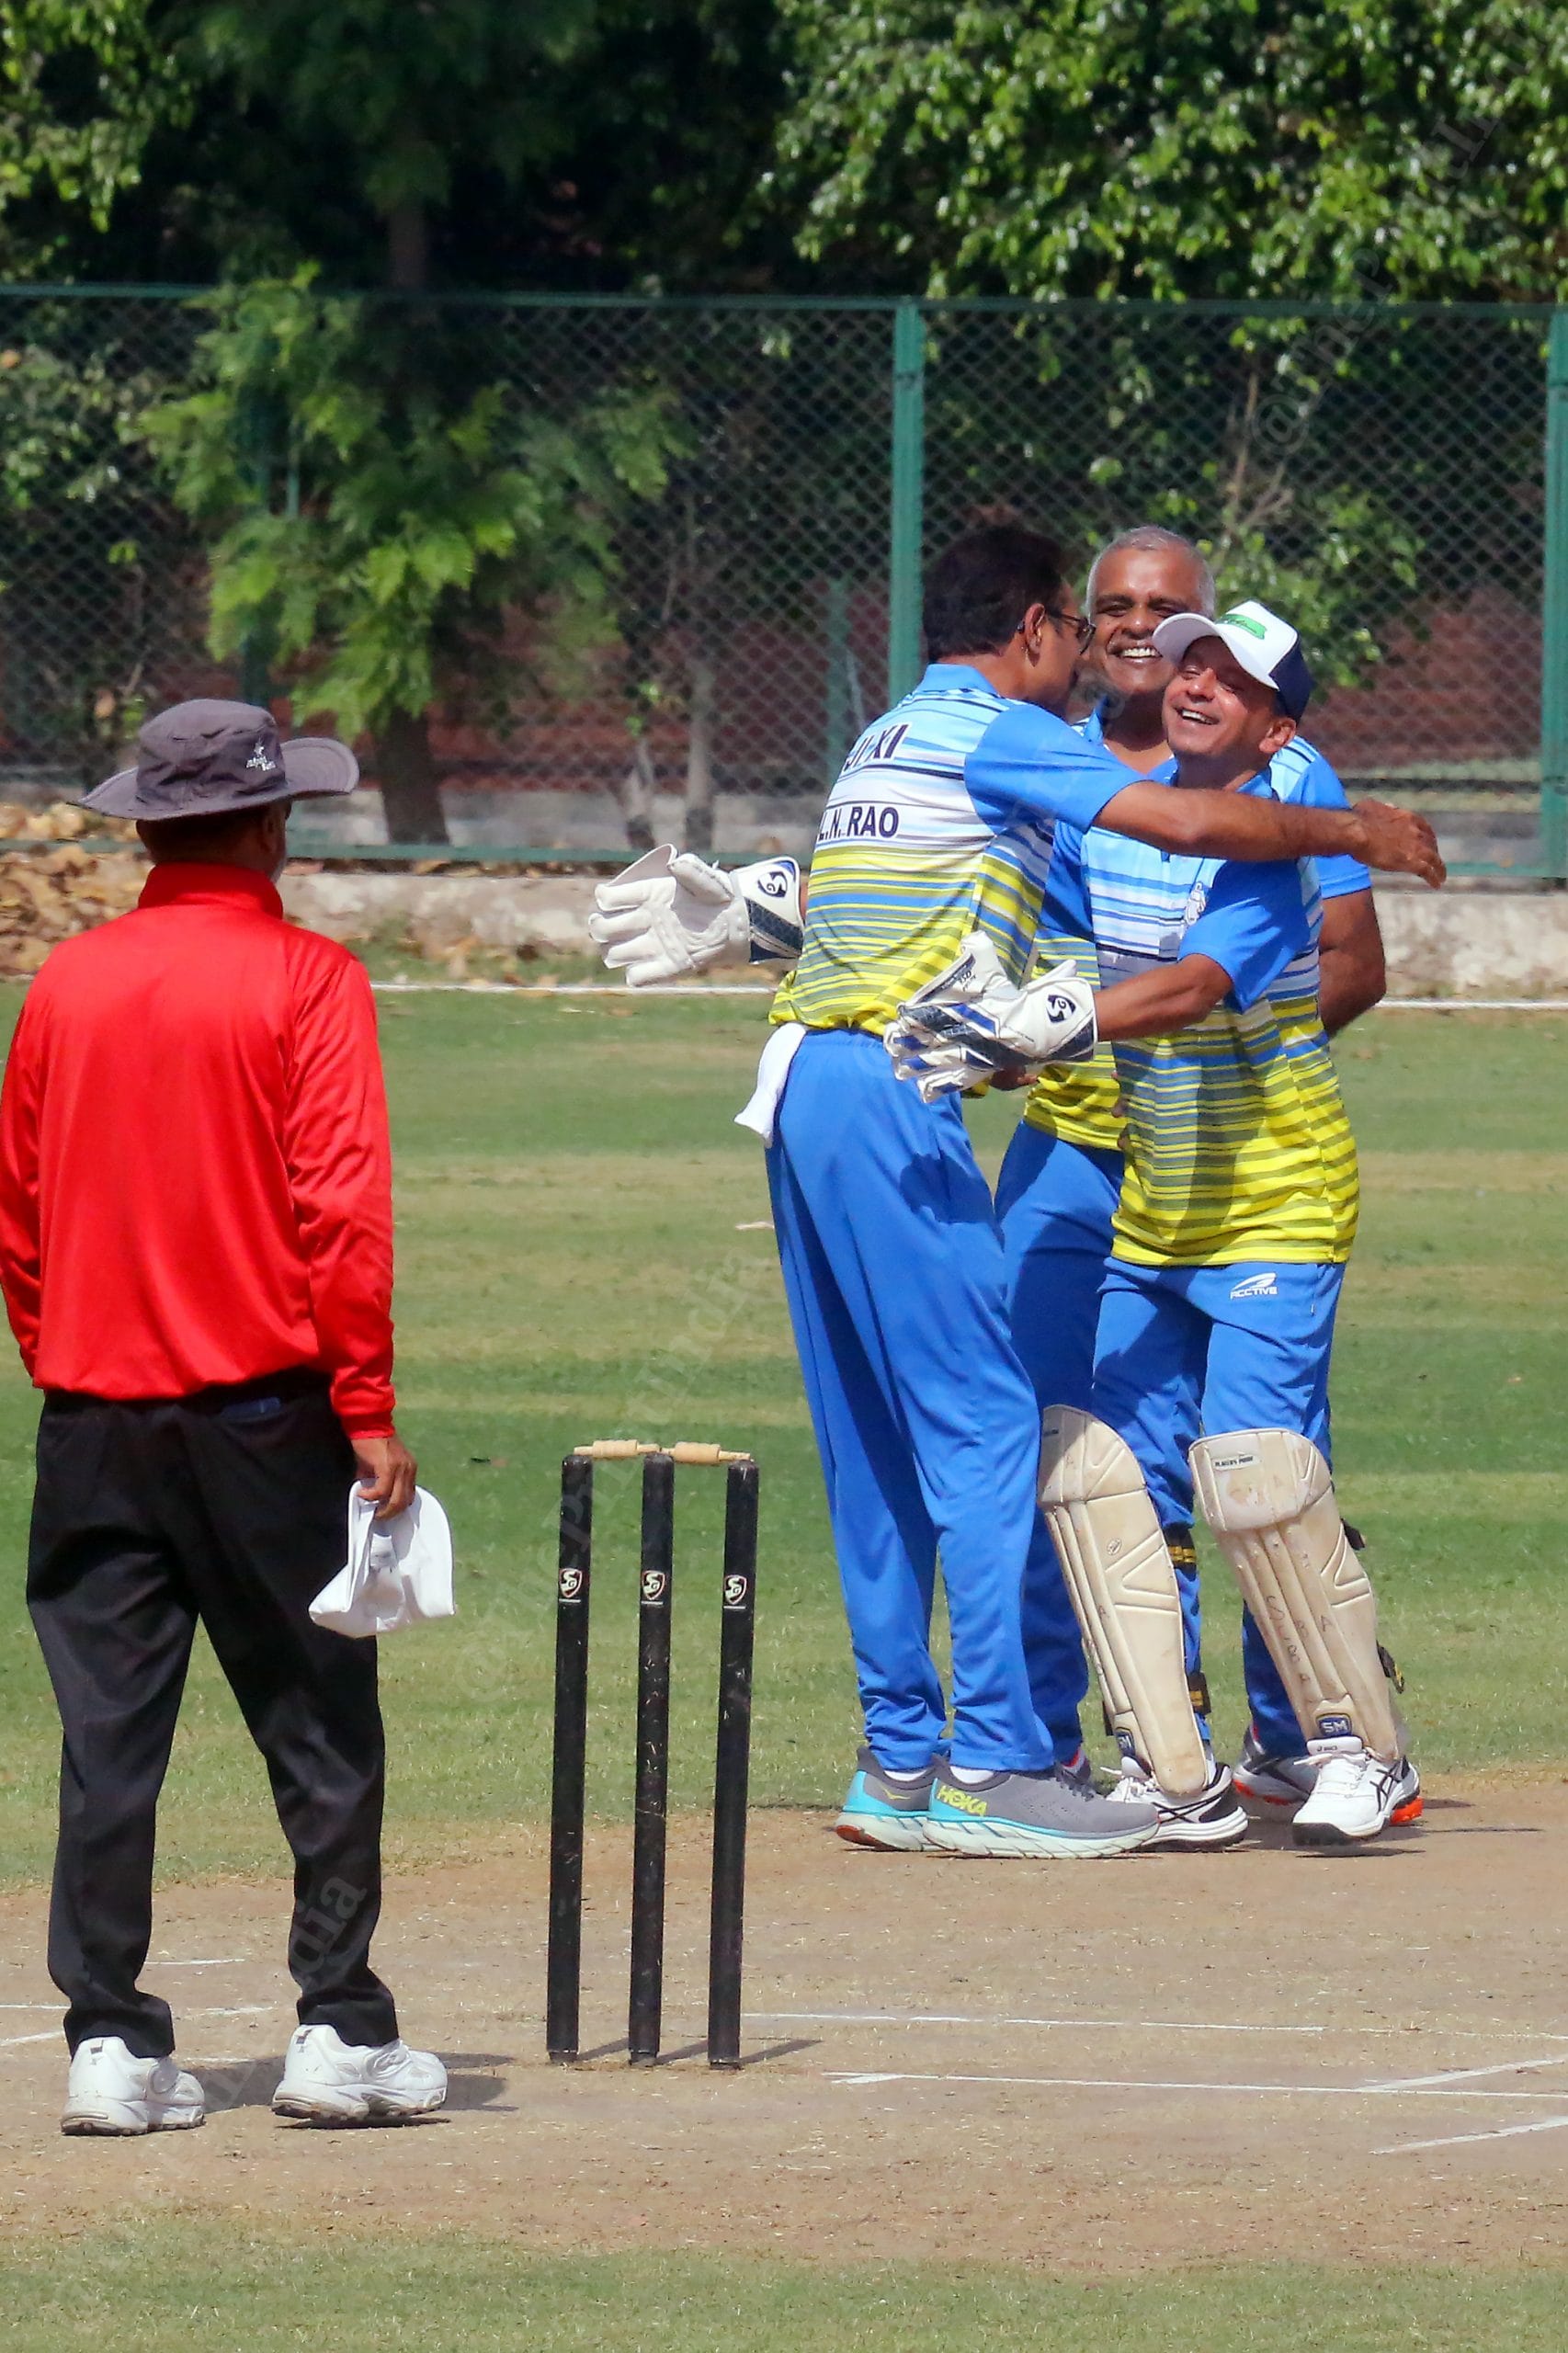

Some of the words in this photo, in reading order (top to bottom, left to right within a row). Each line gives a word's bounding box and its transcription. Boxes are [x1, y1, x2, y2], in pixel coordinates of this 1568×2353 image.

[846, 805, 900, 838] RAO
[1321, 1720, 1348, 1733] SM
[937, 1785, 988, 1817] HOKA
